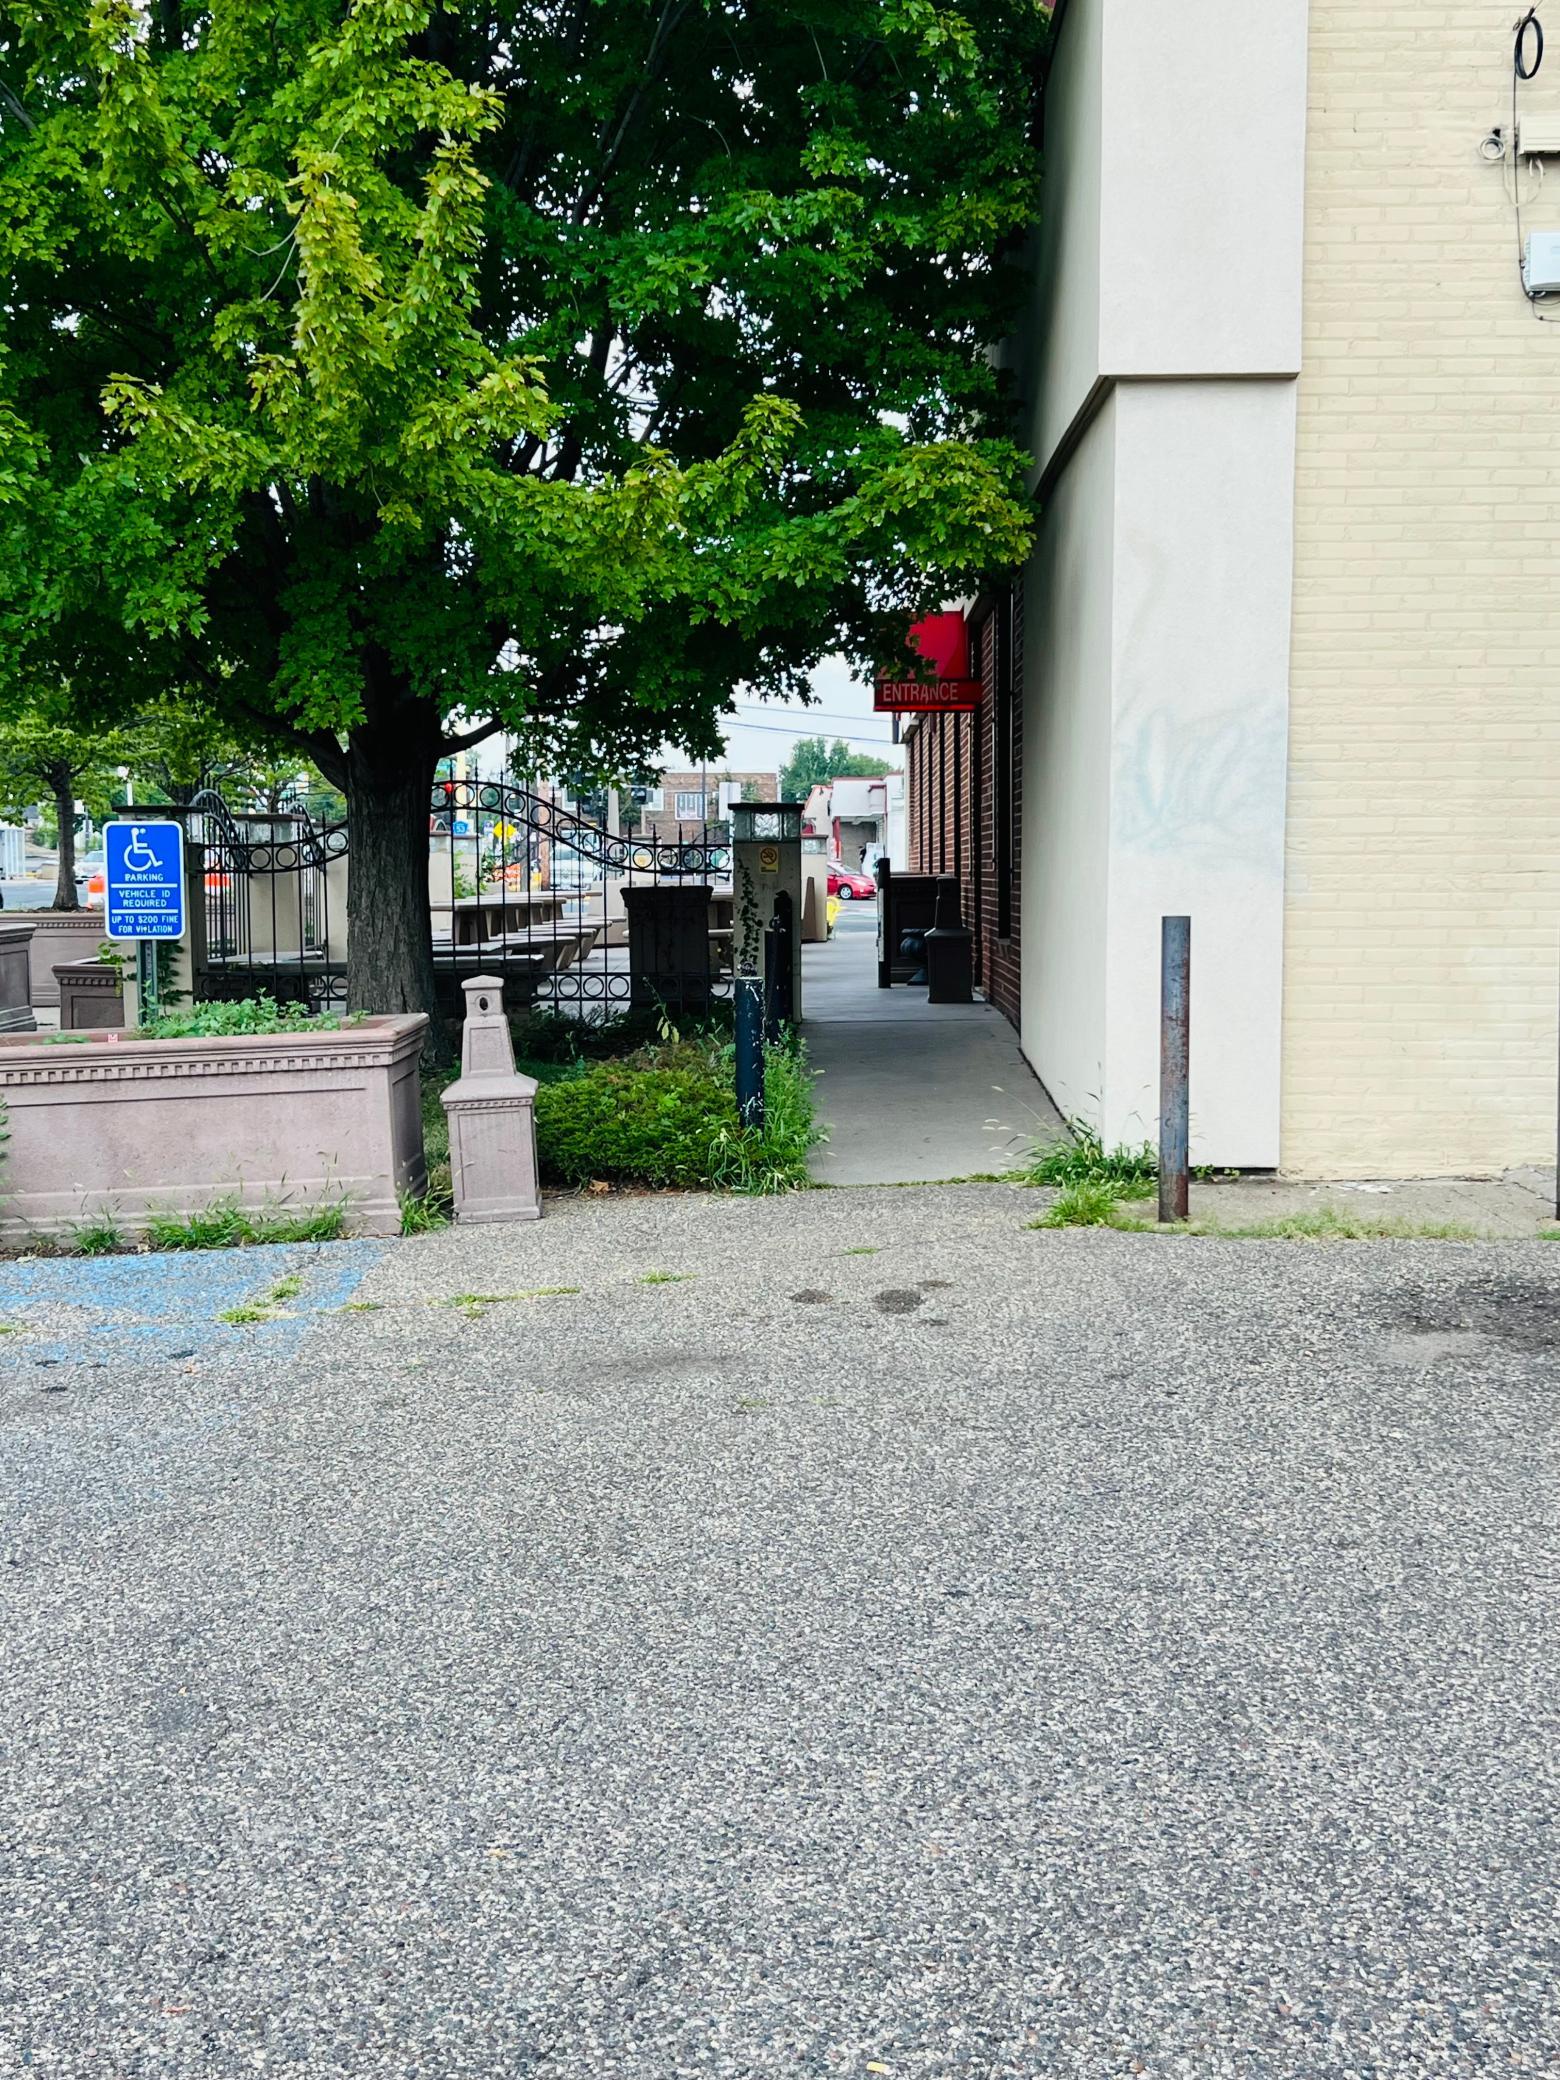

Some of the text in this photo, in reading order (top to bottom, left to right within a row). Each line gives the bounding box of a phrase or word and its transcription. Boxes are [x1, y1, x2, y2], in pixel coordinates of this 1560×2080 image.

[883, 682, 958, 703] ENTRANCE
[124, 873, 164, 882] PARKING
[118, 889, 171, 898] VEHICLE ID
[122, 899, 167, 907] REQUIRED
[111, 915, 179, 924] UP TO $200 FINE
[118, 925, 173, 934] FOR VILATION
